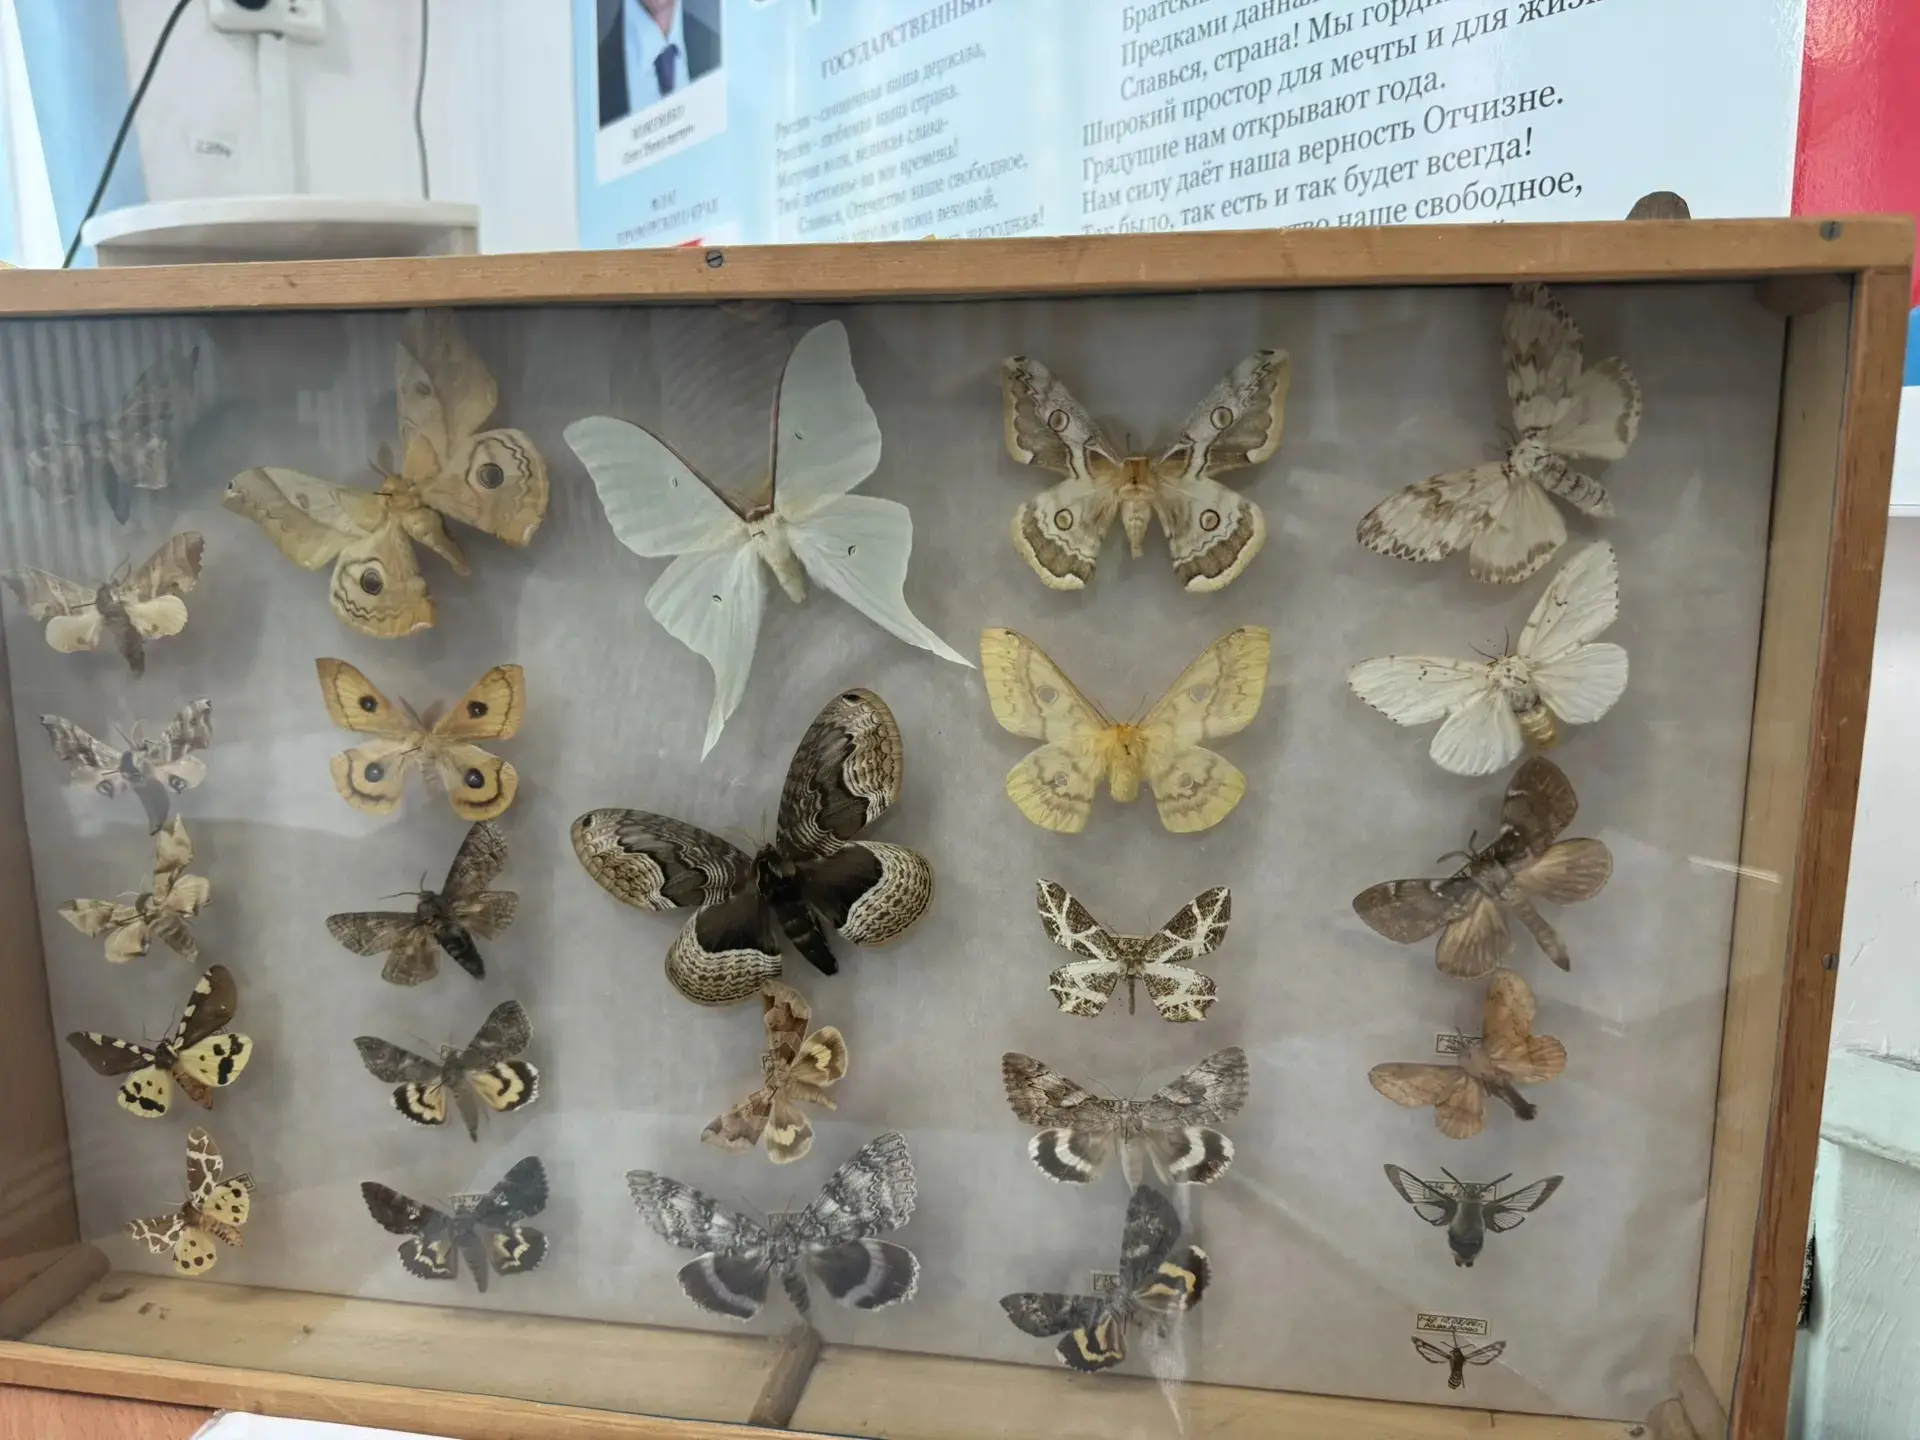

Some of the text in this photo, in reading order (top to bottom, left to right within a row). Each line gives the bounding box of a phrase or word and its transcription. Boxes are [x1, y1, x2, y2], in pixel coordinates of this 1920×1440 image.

[820, 0, 992, 80] ГОСУДАРСТВЕННЫ
[1119, 0, 1450, 101] Славься, страна! Мы горд
[1120, 0, 1321, 67] Предками данна
[1121, 0, 1210, 33] Братск
[1082, 0, 1602, 148] Широкий простор для мечты и для жиз
[1081, 71, 1446, 184] Грядущие нам открывают года.
[1081, 84, 1564, 215] Нам силу даёт наша верность Отчизне.
[1180, 202, 1216, 227] так
[1220, 191, 1268, 218] есть
[1273, 185, 1290, 208] и
[1294, 175, 1338, 202] так
[1343, 158, 1420, 197] будет
[1425, 126, 1533, 177] всегда!
[1414, 170, 1583, 219] свободное,
